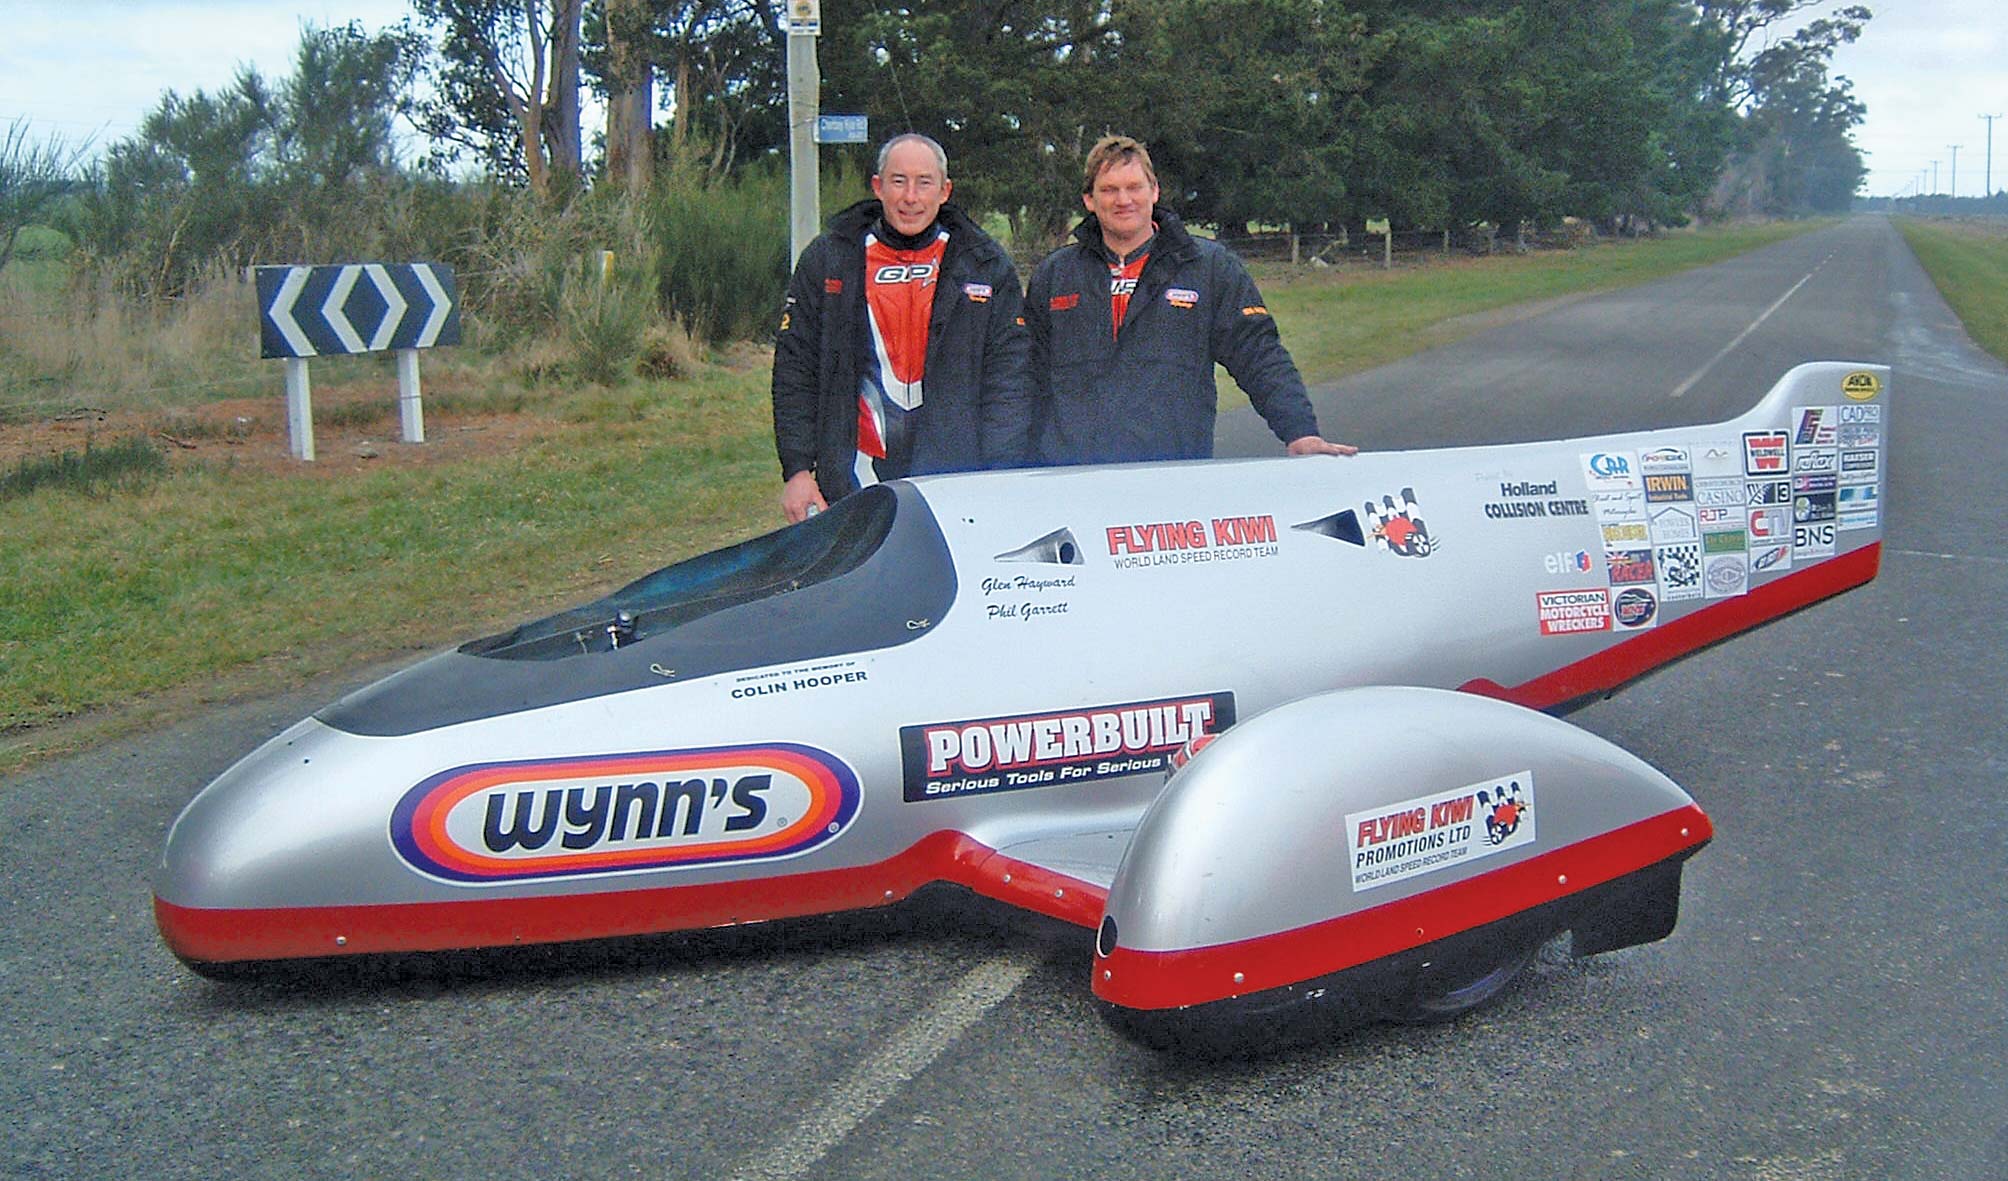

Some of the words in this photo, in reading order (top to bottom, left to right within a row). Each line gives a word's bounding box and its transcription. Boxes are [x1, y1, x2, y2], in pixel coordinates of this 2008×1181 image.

[1500, 480, 1557, 497] Holland
[1647, 475, 1687, 491] IRWIN
[1697, 489, 1744, 505] CASINO
[1484, 501, 1547, 519] COLLISION
[1548, 500, 1589, 516] CENTRE
[1106, 520, 1208, 555] FLYING
[1211, 515, 1278, 547] KIWI
[1795, 525, 1834, 547] BNS
[1114, 555, 1151, 569] WORLD
[1153, 553, 1179, 566] LAND
[1181, 551, 1212, 564] SPEED
[1214, 548, 1253, 561] RECORD
[1255, 546, 1279, 557] TEAM
[1545, 552, 1573, 573] elf
[981, 577, 1011, 596] Glen
[1013, 575, 1075, 592] Hayward
[1542, 593, 1605, 605] VICTORIAN
[987, 603, 1016, 620] Phil
[1020, 602, 1068, 621] Garrett
[1541, 604, 1610, 620] MOTORCYCLE
[1547, 616, 1605, 632] WRECKERS
[736, 672, 779, 682] DEDICATED
[811, 663, 843, 671] MEMORY
[731, 681, 787, 699] COLIN
[793, 671, 868, 690] HOOPER
[927, 702, 1211, 772] POWERBUILT
[926, 776, 999, 794] Serious
[1006, 770, 1054, 785] Tools
[1059, 765, 1092, 779] For
[1096, 757, 1161, 775] Serious
[1357, 807, 1426, 848] FLYING
[1430, 794, 1474, 829] KIWI
[1356, 832, 1445, 868] PROMOTIONS
[1449, 825, 1471, 843] LTD
[1355, 868, 1380, 883] WORLD
[1381, 864, 1400, 877] LAND
[1400, 859, 1422, 873] SPEED
[1423, 851, 1450, 866] RECORD
[1451, 846, 1468, 858] TEAM
